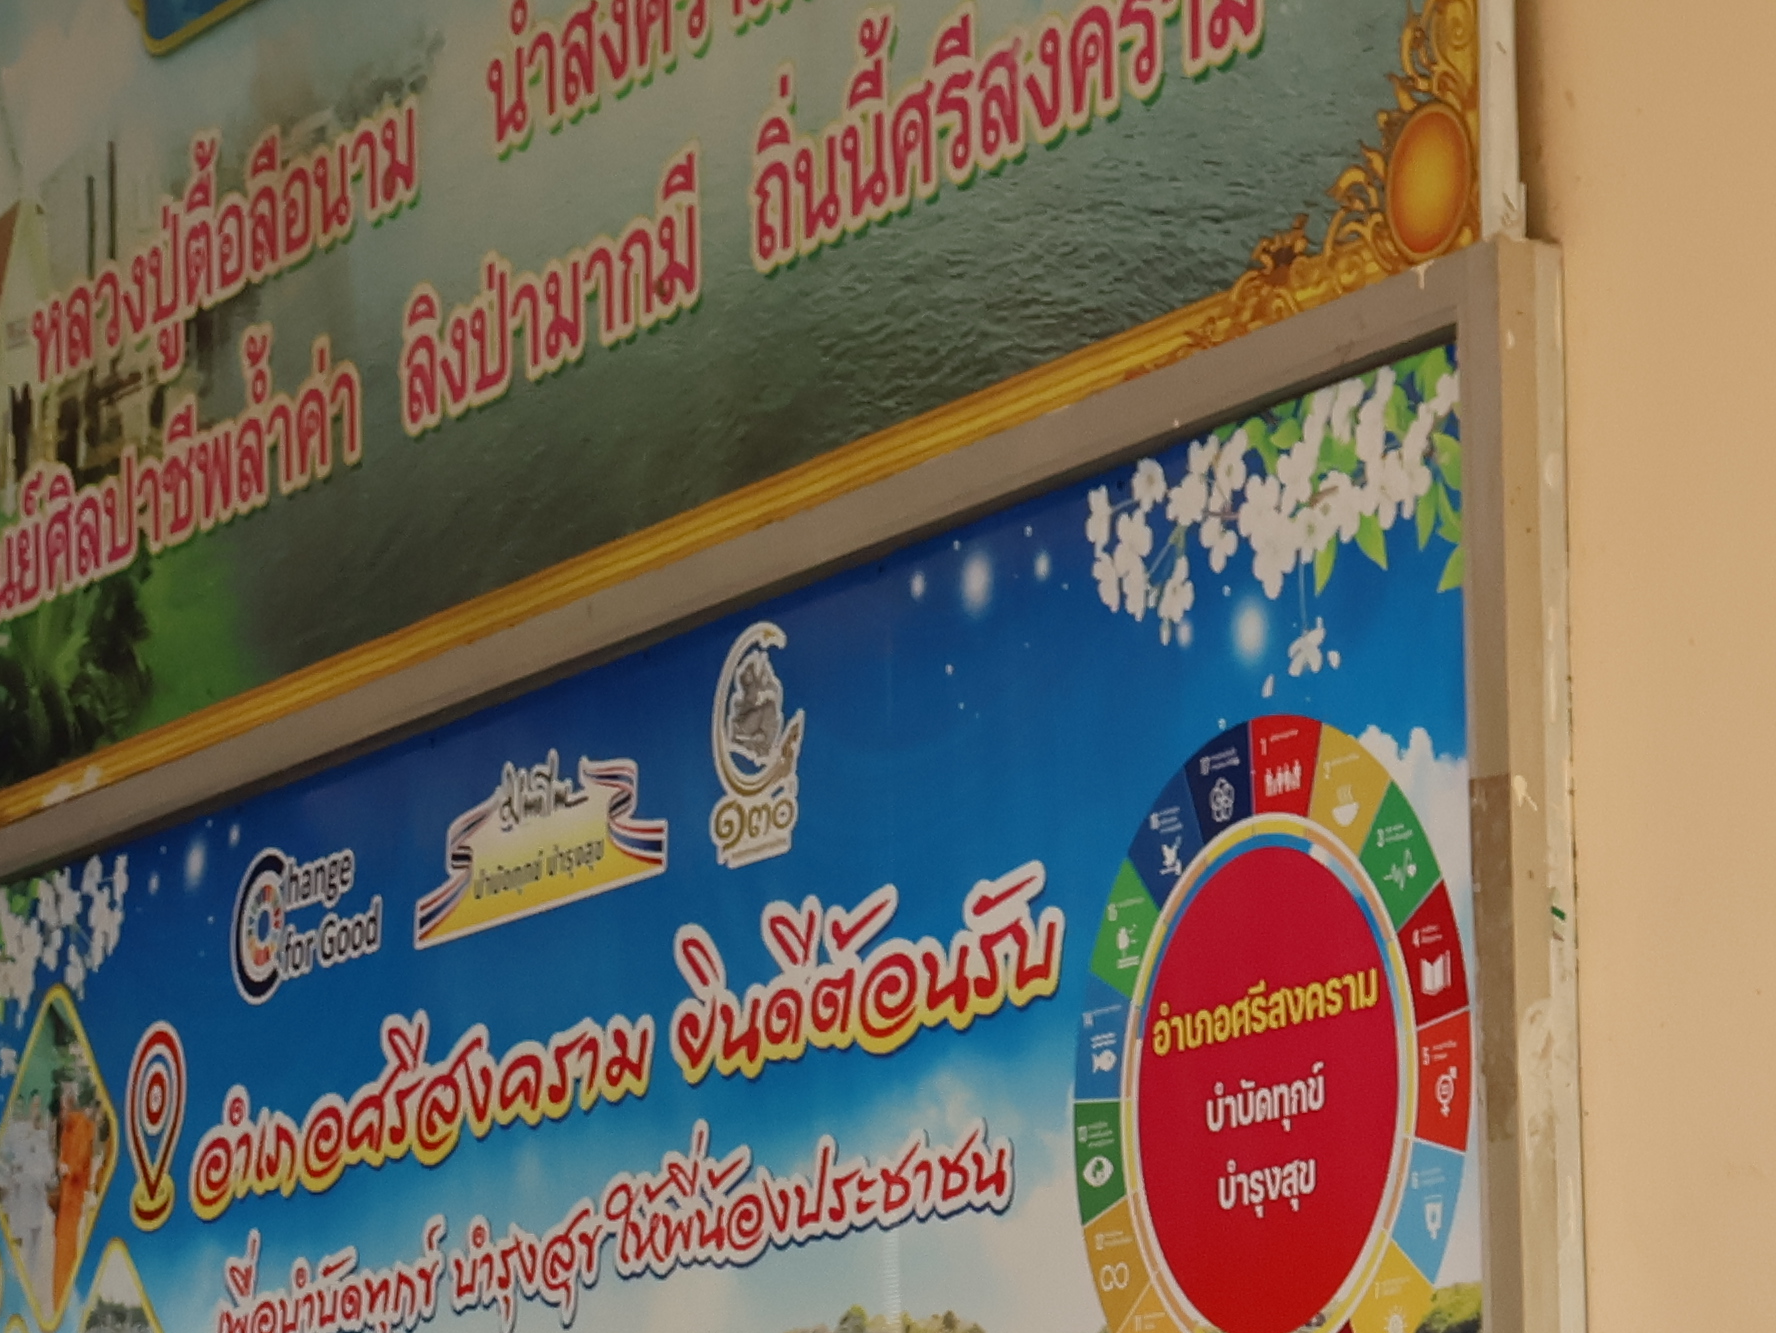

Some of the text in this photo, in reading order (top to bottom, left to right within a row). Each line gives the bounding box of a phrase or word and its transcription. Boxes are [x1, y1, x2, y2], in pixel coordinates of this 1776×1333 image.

[30, 103, 419, 370] หลวงปู่ตื้อลือนาม
[402, 151, 698, 428] ลิงป่ามากมี
[283, 901, 380, 974] for Good
[194, 874, 1057, 1207] อำเภอศรีสงคราม ยินดีต้อนรับ
[1151, 967, 1380, 1057] อำเภอศรีสงคราม
[1205, 1060, 1326, 1132] บำบัดทุกข์
[453, 1208, 603, 1326] บำรุงสุข
[605, 1128, 1007, 1263] ให้พี่น้องประชาชน
[1217, 1157, 1317, 1218] บำรุงสุข
